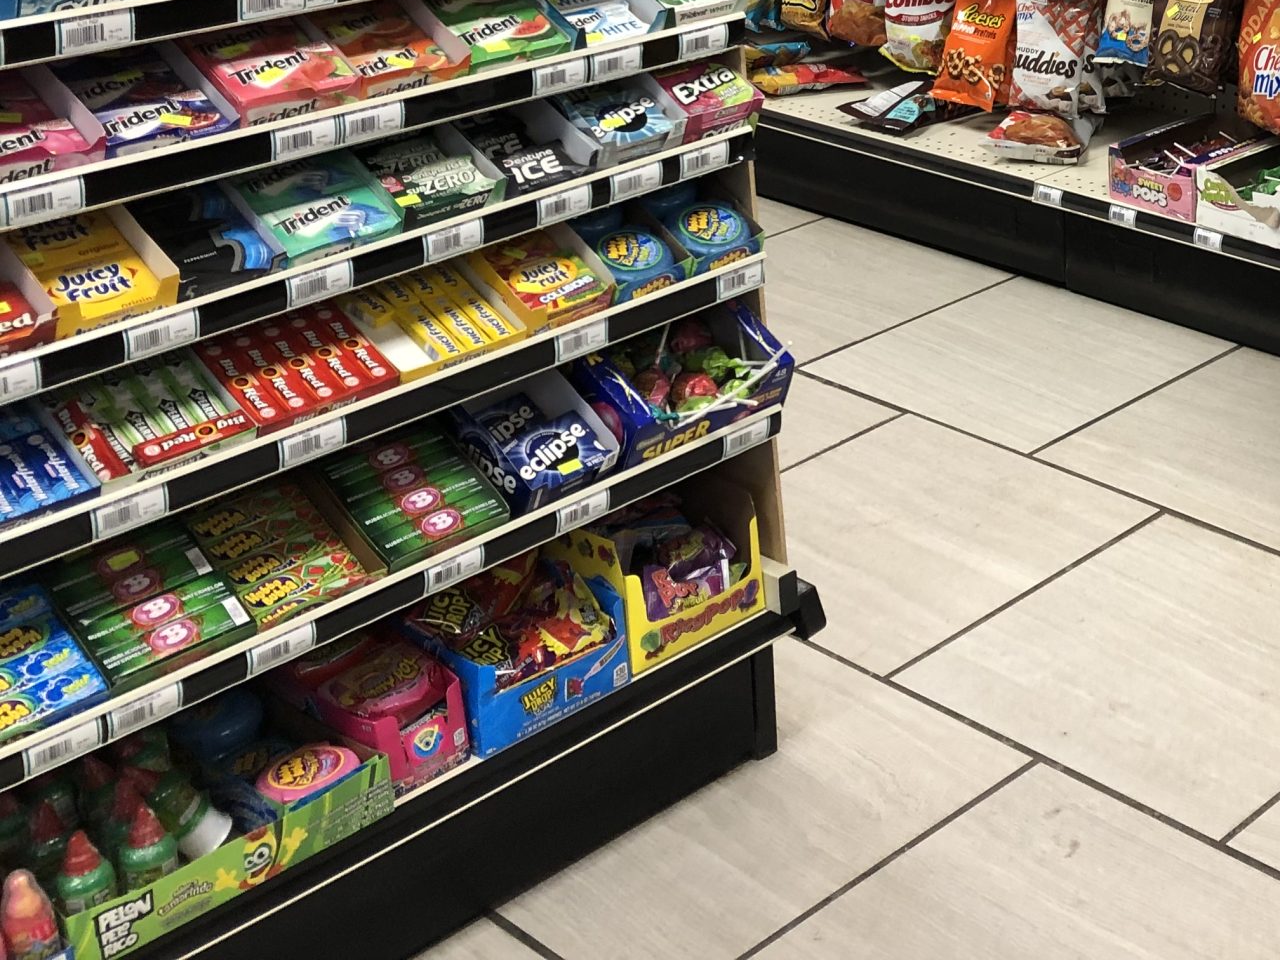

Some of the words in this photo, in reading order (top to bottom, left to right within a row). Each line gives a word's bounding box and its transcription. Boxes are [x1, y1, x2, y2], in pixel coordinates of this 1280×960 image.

[680, 8, 709, 21] Trident
[710, 3, 733, 15] WHITE
[962, 4, 1004, 28] Reese's
[460, 13, 520, 46] Trident
[973, 27, 997, 39] Pretzels
[230, 51, 308, 86] Trident
[672, 67, 735, 101] Extra
[102, 98, 182, 137] Trident
[503, 149, 553, 168] Dentyne
[512, 157, 564, 184] ICE
[424, 171, 477, 195] ZERO
[1132, 184, 1168, 208] POPS
[1138, 178, 1165, 192] SWEET
[273, 195, 351, 236] Trident
[56, 264, 120, 291] Juicy
[520, 261, 558, 284] Juicy
[67, 277, 131, 303] Fruit
[538, 276, 594, 304] COLLISIONS
[328, 356, 352, 378] Red
[356, 346, 377, 368] Red
[272, 378, 296, 399] Red
[300, 368, 323, 389] Red
[244, 388, 266, 409] Red
[57, 409, 74, 435] Big
[81, 447, 104, 472] Red
[161, 431, 195, 451] Red
[520, 422, 586, 481] eclipse
[643, 419, 711, 460] SUPER
[523, 677, 556, 707] JUICY
[98, 892, 152, 926] PELON
[102, 933, 138, 959] RICO
